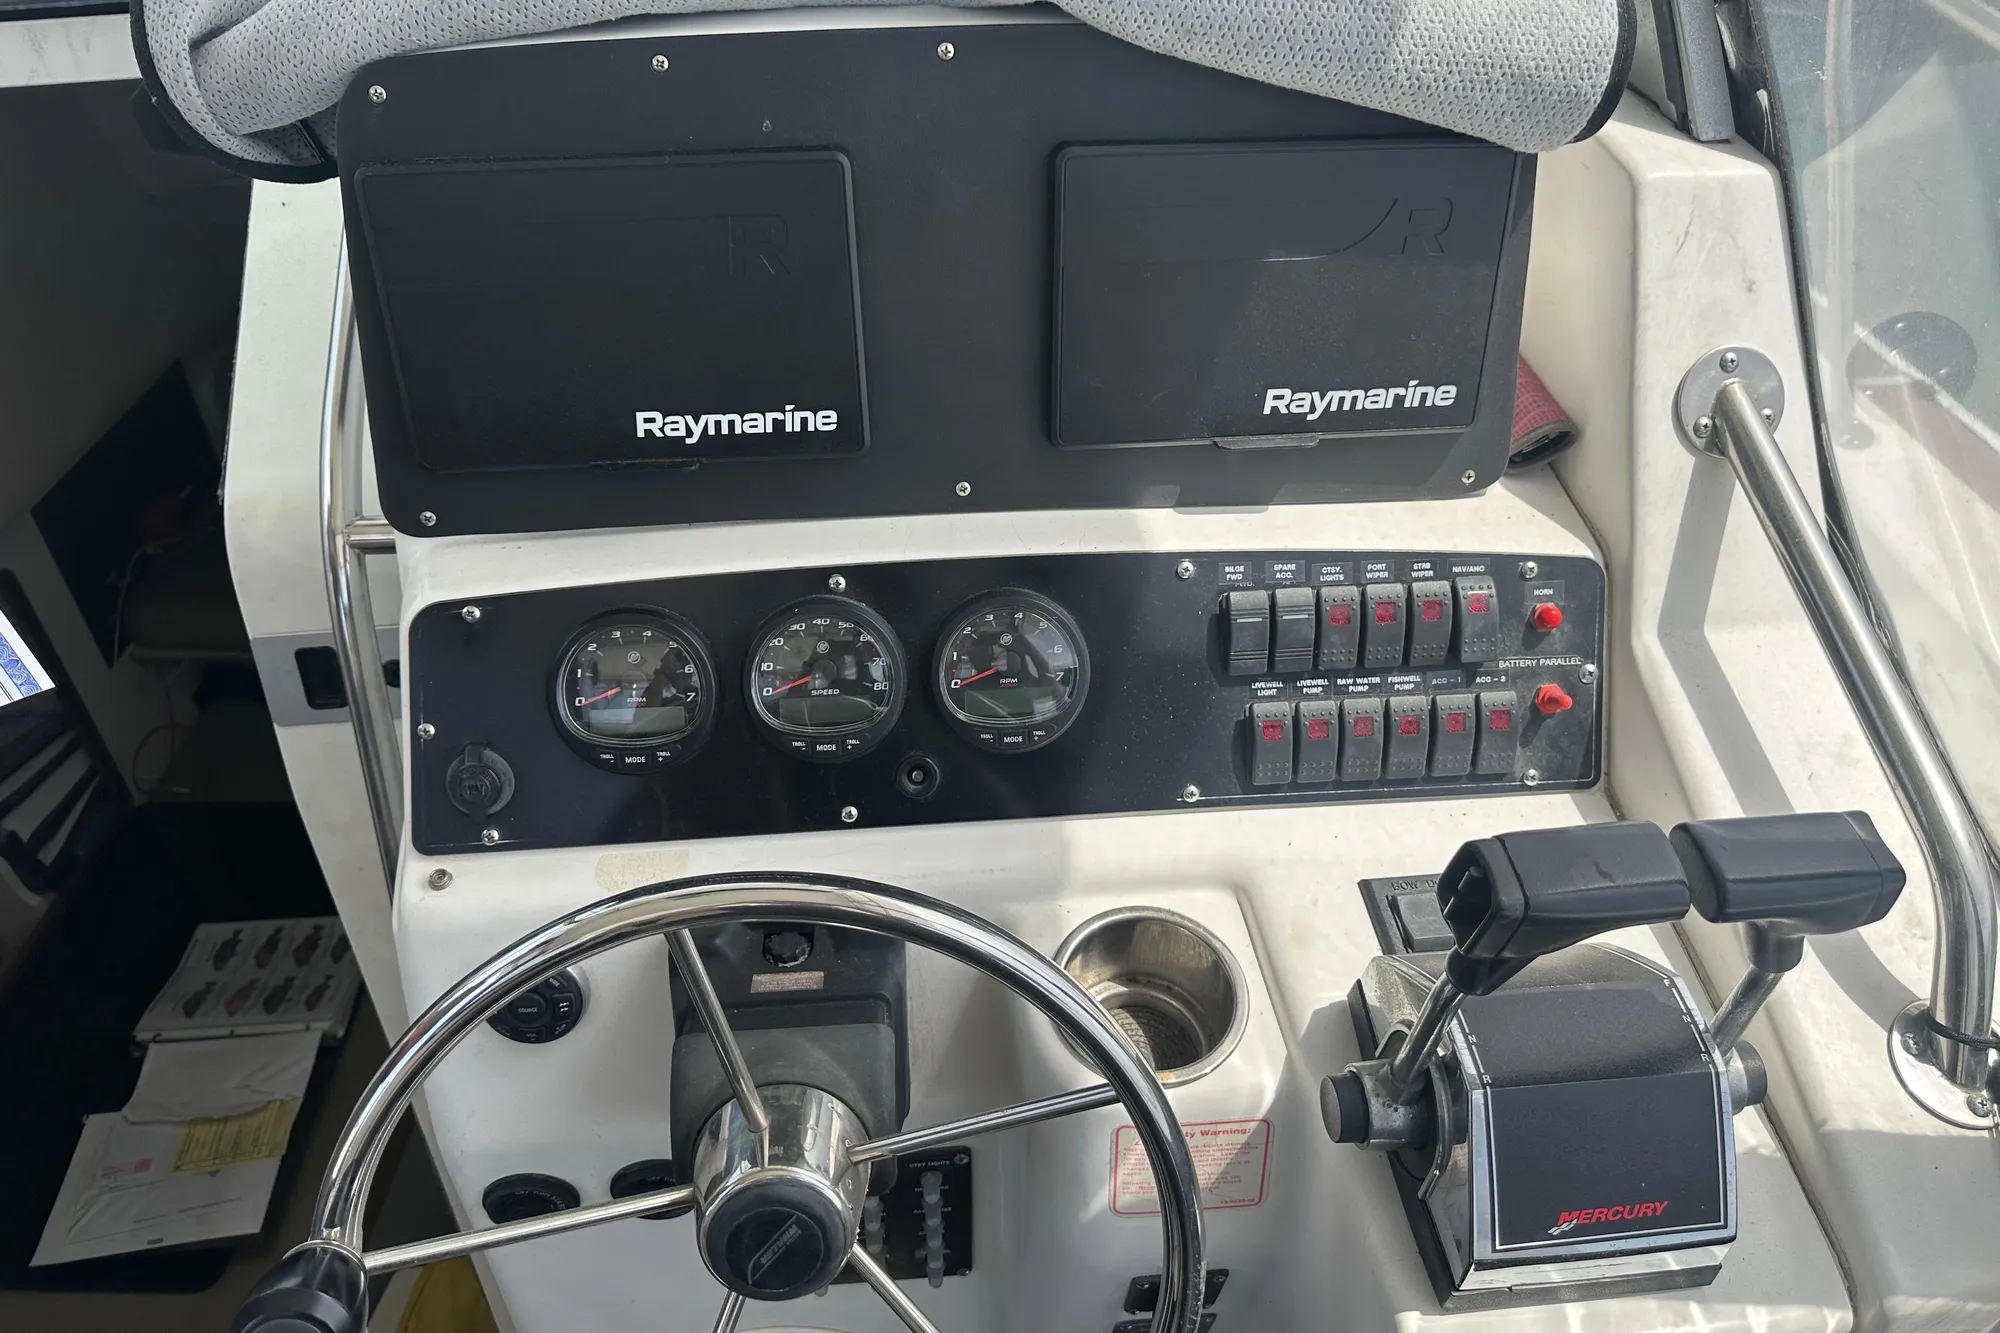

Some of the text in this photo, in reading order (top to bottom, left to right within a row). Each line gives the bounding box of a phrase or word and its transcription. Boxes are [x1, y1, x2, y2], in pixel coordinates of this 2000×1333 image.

[1263, 379, 1457, 421] Raymarine
[635, 404, 838, 444] Raymarine
[1367, 563, 1387, 571] PORT
[1452, 565, 1485, 573] NAV/ANC
[1411, 570, 1434, 578] WIPER
[1533, 588, 1554, 596] HORN
[789, 623, 806, 631] 30
[838, 621, 855, 629] 50
[1039, 621, 1048, 629] 5
[611, 630, 621, 638] 3
[860, 634, 874, 642] 60
[769, 638, 784, 646] 20
[587, 643, 597, 651] 2
[1053, 645, 1063, 653] 6
[872, 657, 886, 666] 70
[1499, 657, 1582, 668] BATTERY PARALLEL
[684, 664, 694, 673] 6
[761, 662, 774, 671] 10
[1055, 672, 1065, 681] 7
[1388, 675, 1421, 684] FISHWELL
[951, 680, 961, 689] 0
[1252, 681, 1284, 689] LIVEWELL
[1297, 679, 1329, 687] LIVEWELL
[1432, 677, 1448, 685] ACC
[873, 682, 889, 691] 80
[1348, 685, 1369, 693] PUMP
[1394, 683, 1415, 691] PUMP
[762, 688, 773, 696] 0
[811, 688, 840, 696] SPEED
[1303, 687, 1323, 695] PUMP
[686, 692, 696, 702] 7
[575, 697, 585, 707] 0
[1003, 735, 1023, 743] MODE
[816, 744, 837, 752] MODE
[1391, 880, 1420, 892] BOW
[1663, 978, 1671, 987] F
[1682, 1014, 1692, 1023] N
[1468, 1034, 1478, 1043] N
[1700, 1053, 1710, 1062] R
[1482, 1074, 1492, 1084] R
[1200, 1127, 1251, 1137] Warning:
[1556, 1200, 1669, 1226] MERCURY
